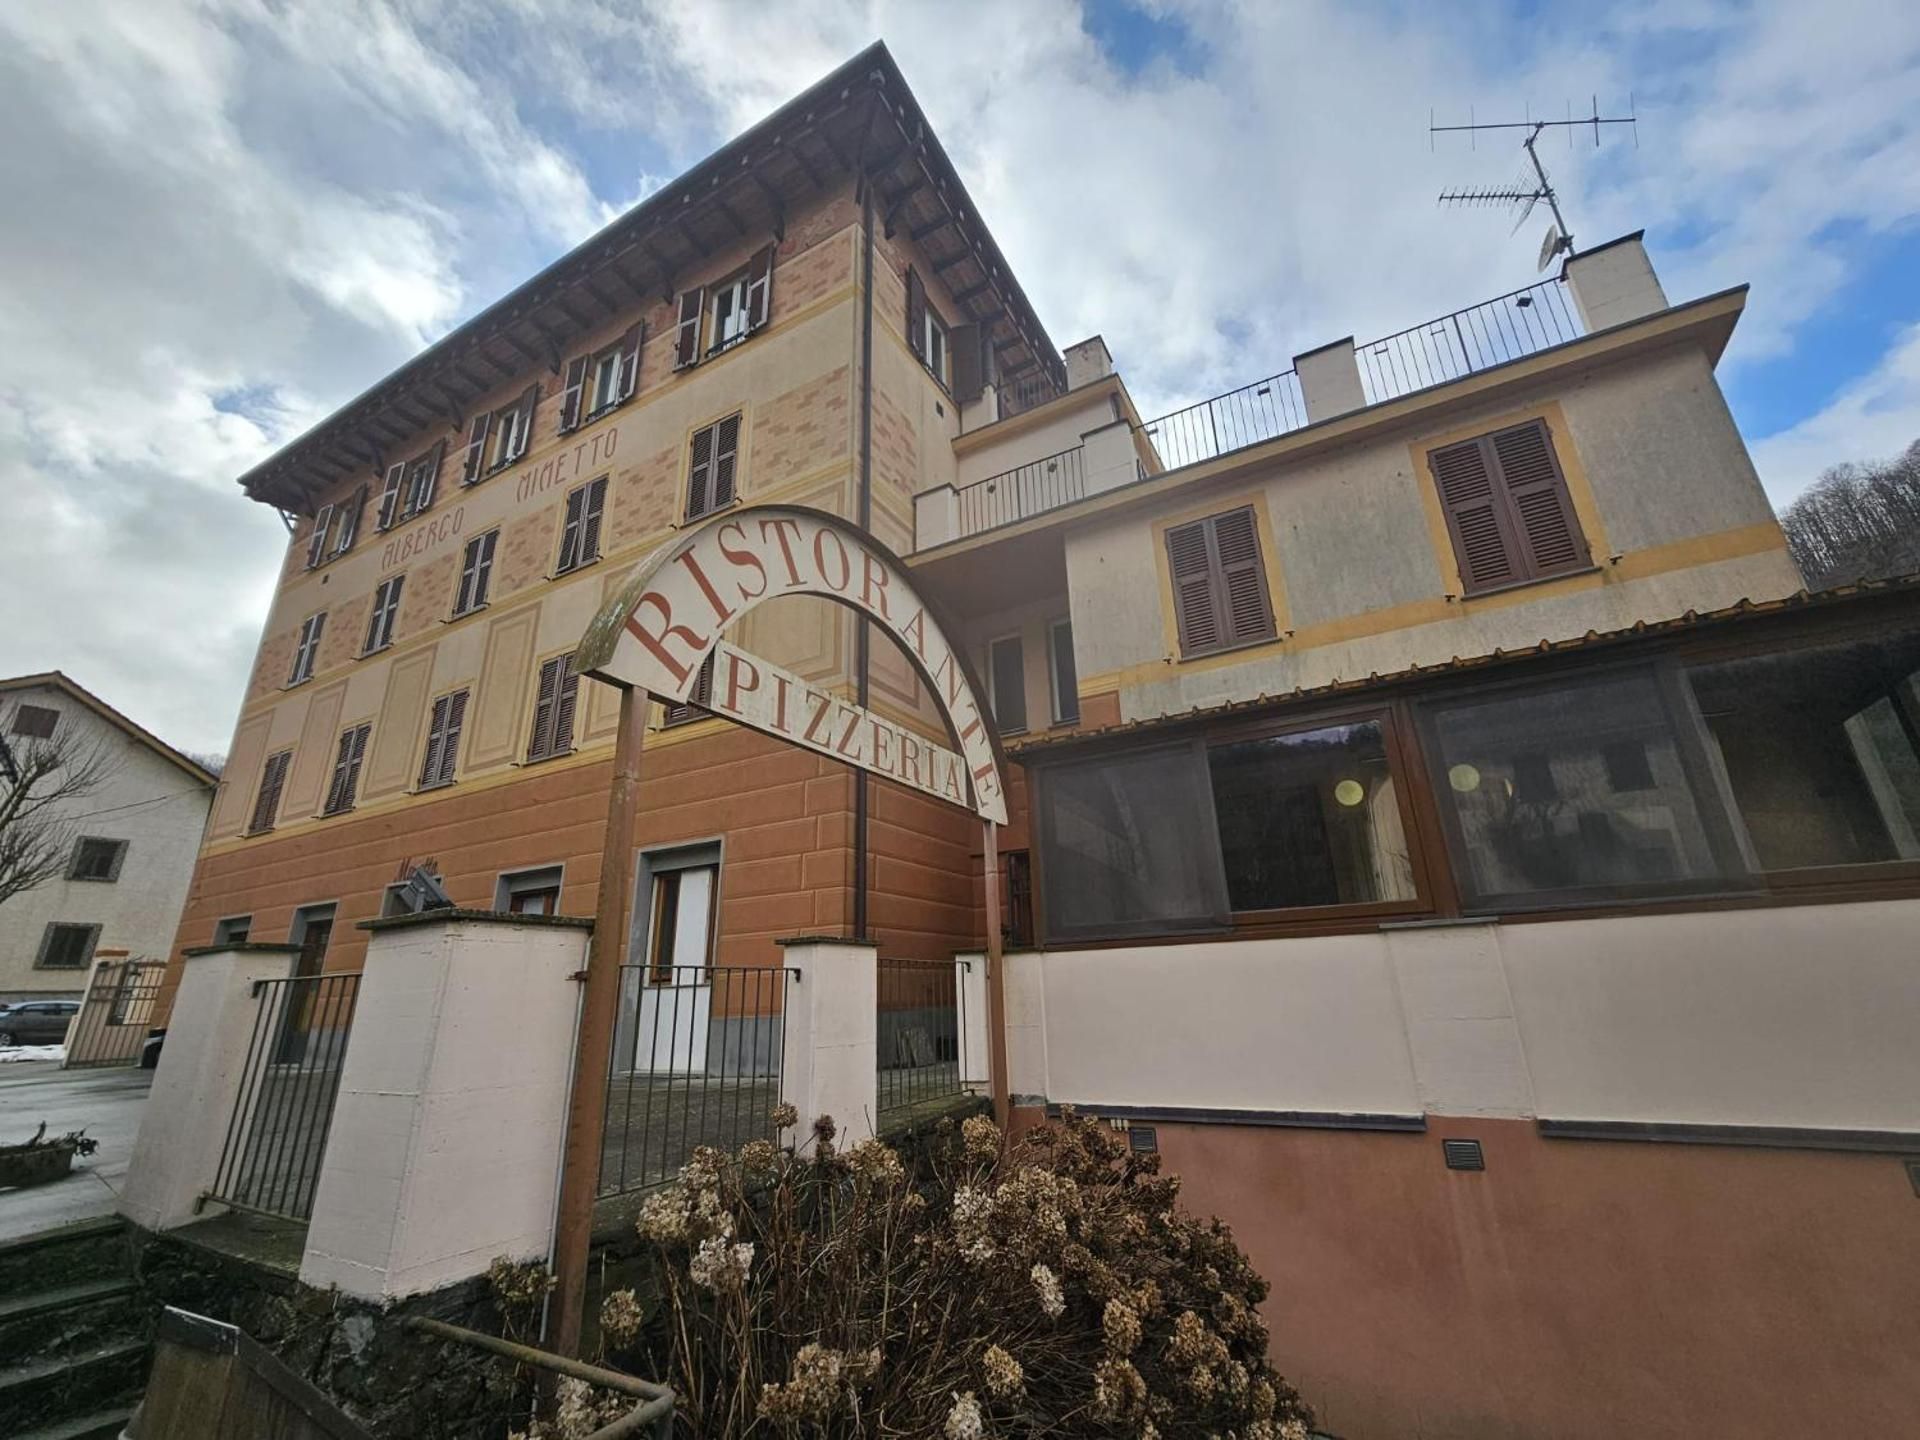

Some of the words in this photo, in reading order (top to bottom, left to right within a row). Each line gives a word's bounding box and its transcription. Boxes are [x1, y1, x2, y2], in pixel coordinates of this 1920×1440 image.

[382, 507, 464, 571] ALBERGO
[623, 518, 1001, 809] RISTORANTE
[720, 649, 964, 802] PIZZERIA
